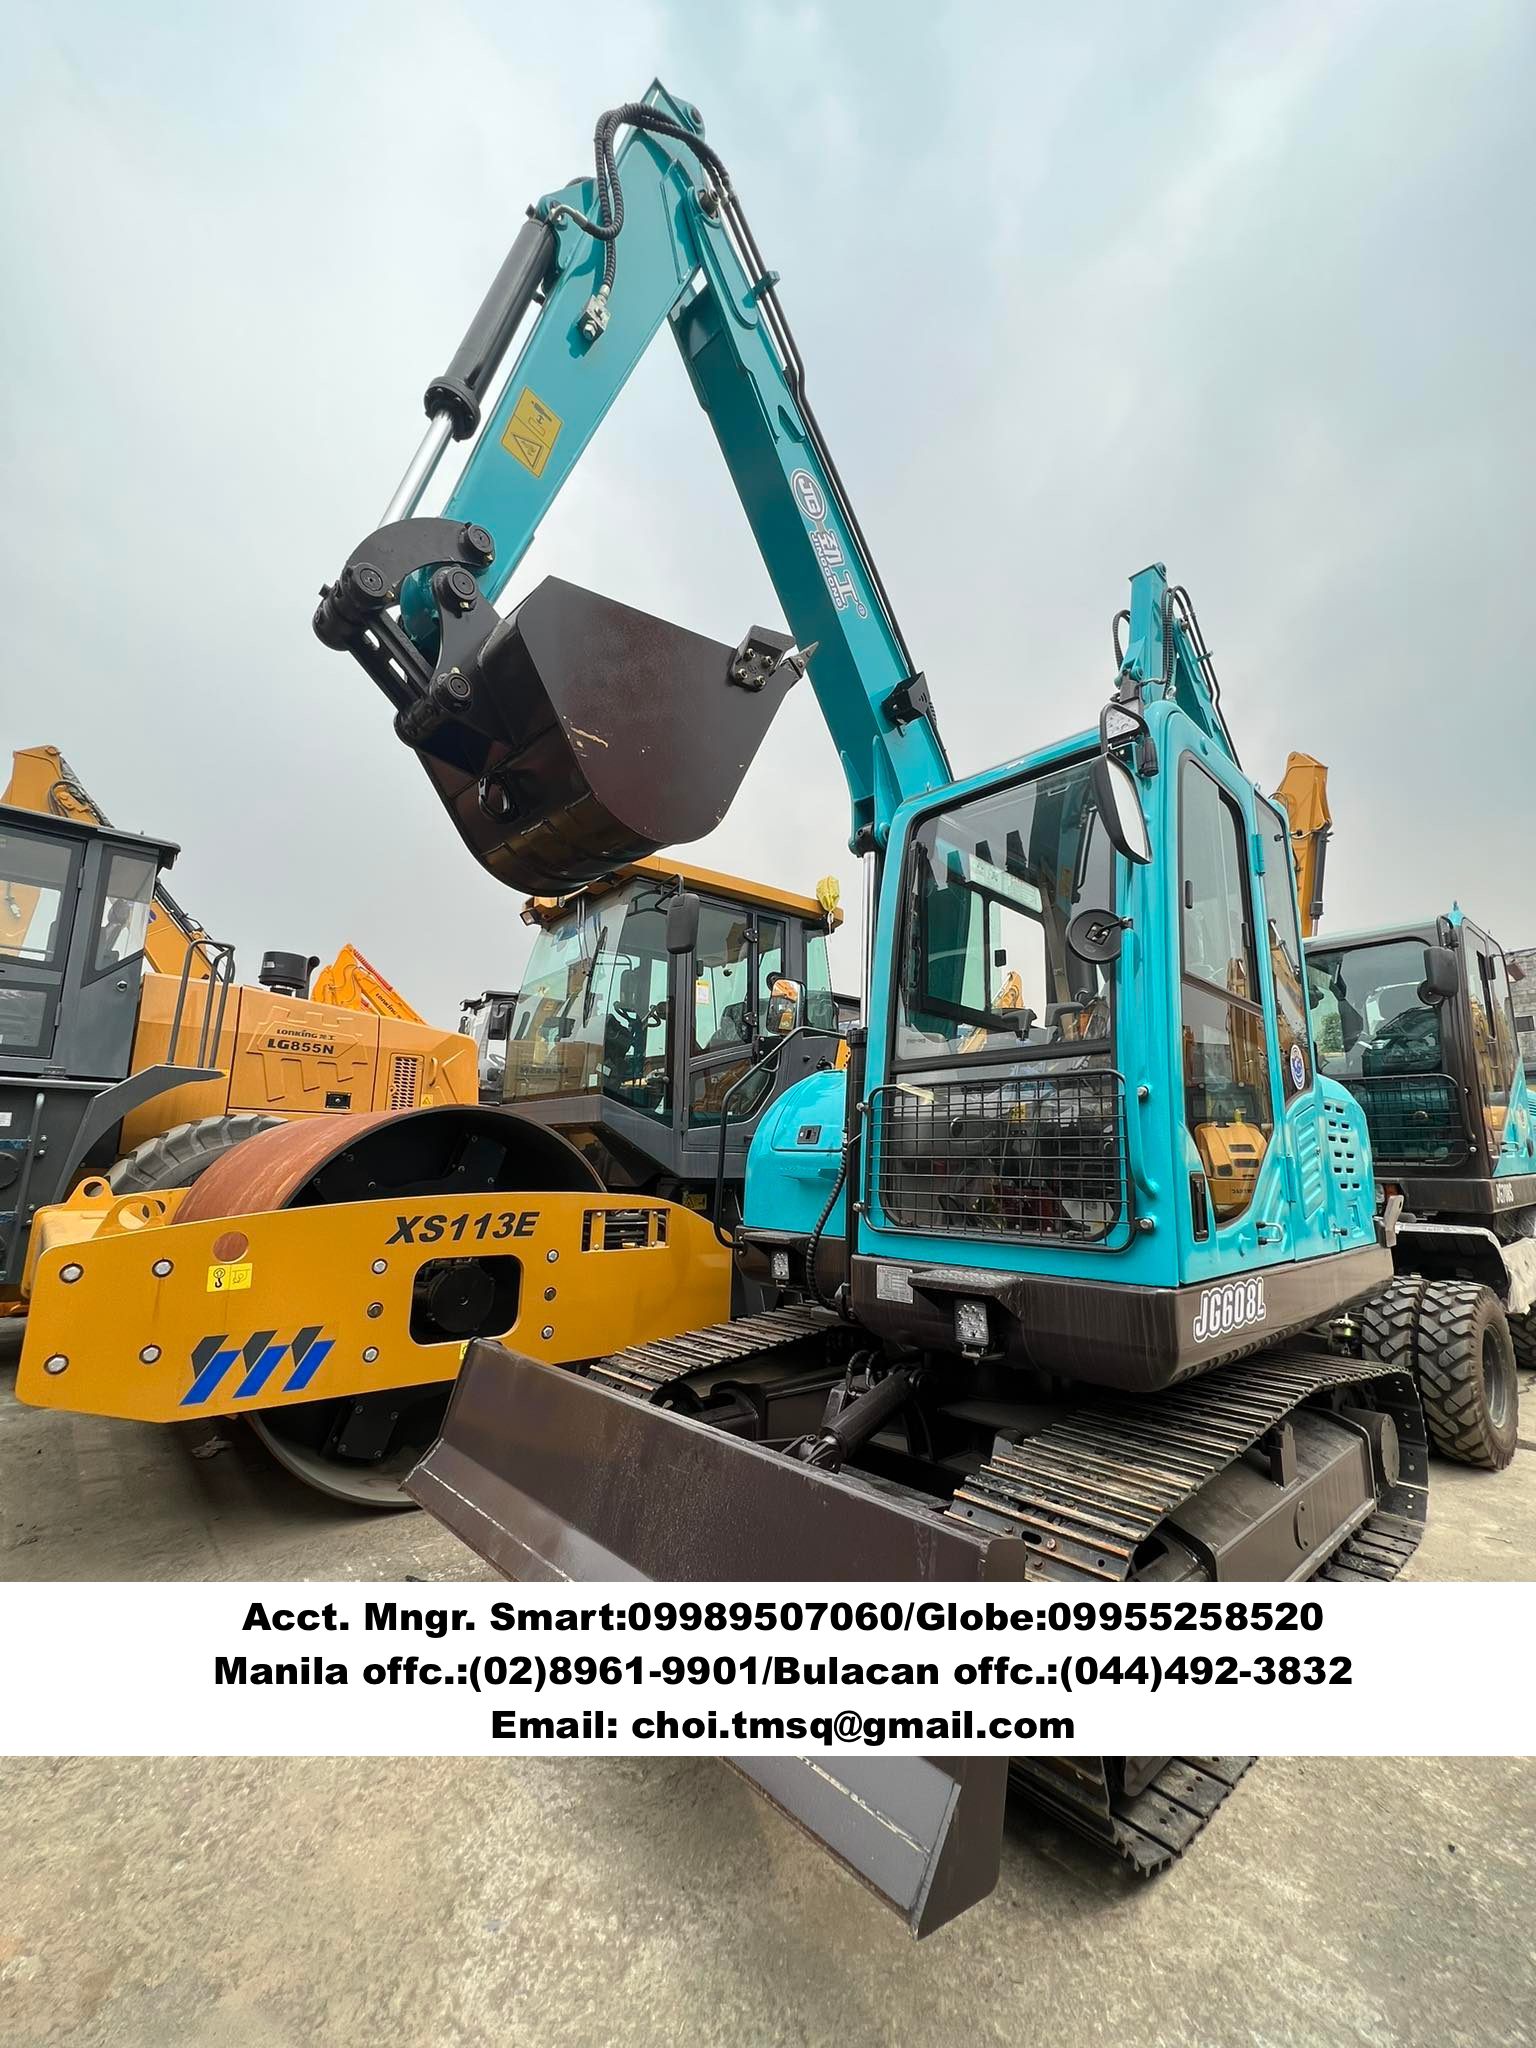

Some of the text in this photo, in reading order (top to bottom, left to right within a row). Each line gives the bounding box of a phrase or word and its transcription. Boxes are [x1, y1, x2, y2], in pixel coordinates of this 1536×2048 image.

[267, 1038, 335, 1055] LG855N
[384, 1211, 540, 1245] XS113E
[1194, 1277, 1266, 1343] JG608L
